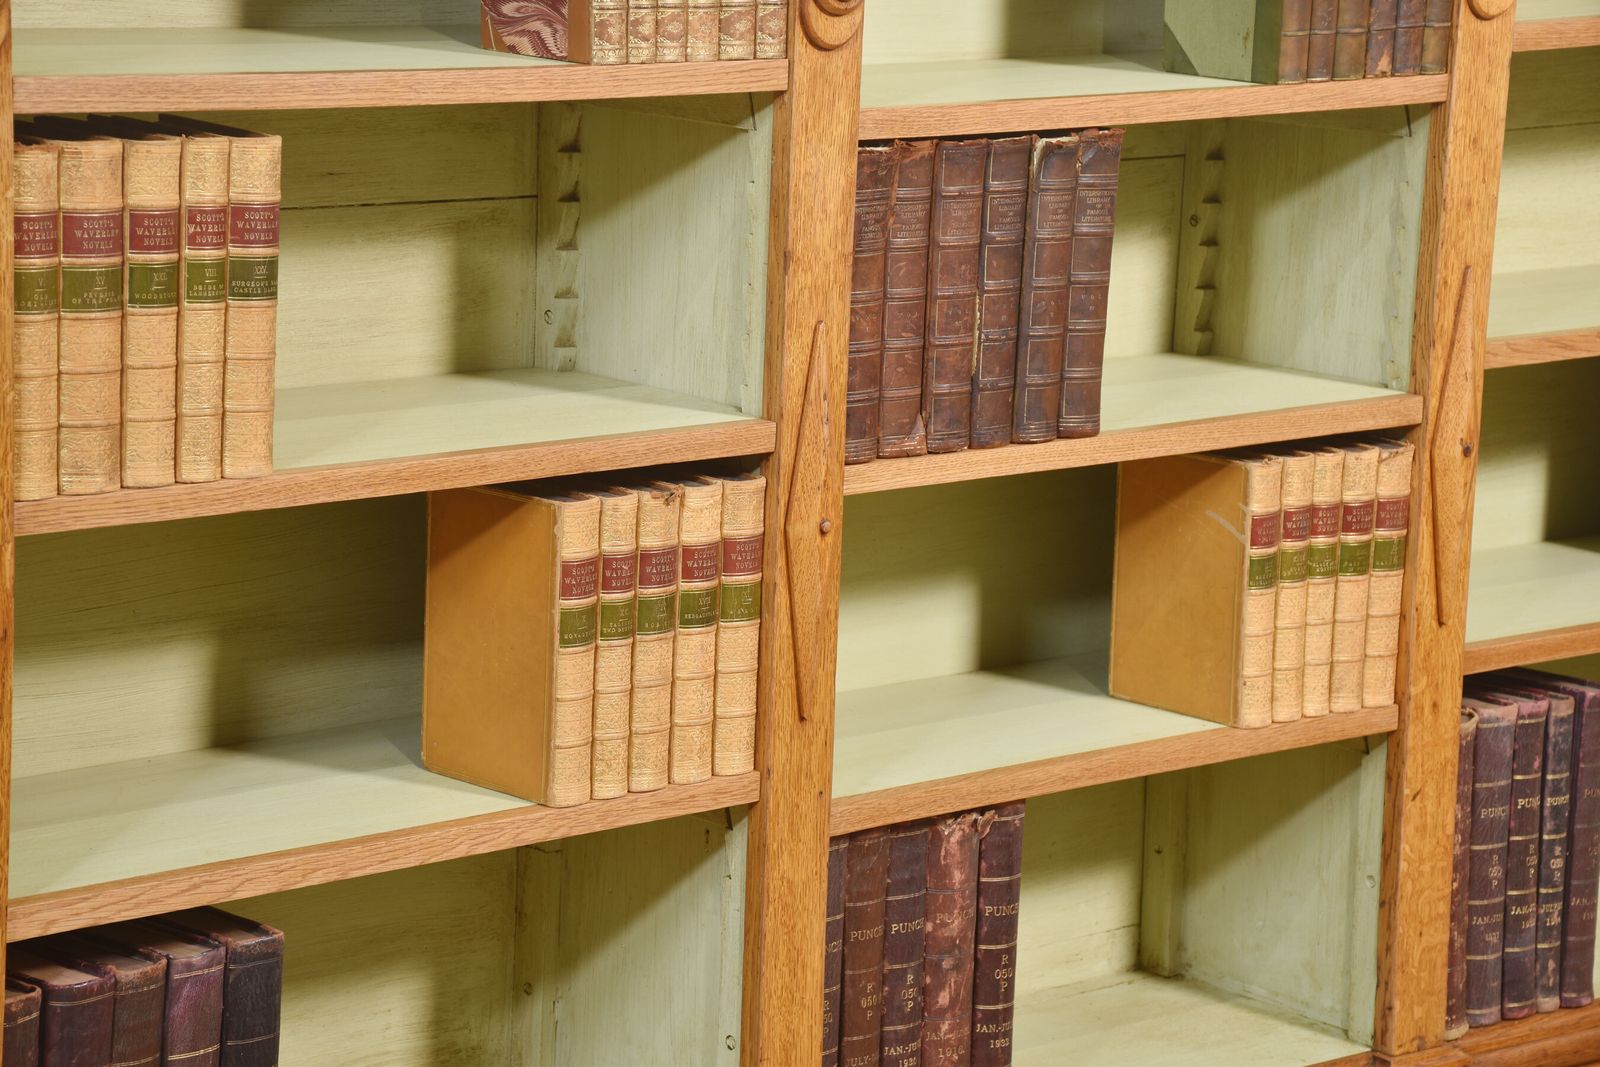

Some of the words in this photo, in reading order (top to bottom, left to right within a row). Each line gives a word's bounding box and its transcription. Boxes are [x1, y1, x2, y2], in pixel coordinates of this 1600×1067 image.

[196, 213, 225, 222] SCOTT'S
[244, 211, 274, 220] SCOTT'S
[83, 220, 114, 229] SCOTT'S
[143, 218, 174, 227] SCOTT'S
[136, 228, 176, 236] WAVERLE
[187, 224, 225, 233] WAVERL
[14, 231, 57, 241] WAVERLE
[196, 235, 224, 244] NOVELS
[244, 232, 273, 241] NOVELS
[24, 242, 54, 252] NOVELS
[83, 241, 113, 249] NOVELS
[143, 238, 174, 247] NOVELS
[685, 558, 718, 568] WAVERL
[604, 568, 633, 578] WAVERL
[644, 563, 674, 574] WAVERL
[1517, 796, 1541, 809] PUNC
[891, 917, 925, 934] PUNCH
[1001, 954, 1009, 965] R
[994, 968, 1014, 980] 050
[906, 974, 915, 985] R
[866, 982, 874, 993] R
[1001, 981, 1008, 992] P
[902, 987, 919, 999] 050
[861, 995, 878, 1009] 050
[906, 1000, 915, 1012] P
[866, 1010, 874, 1021] P
